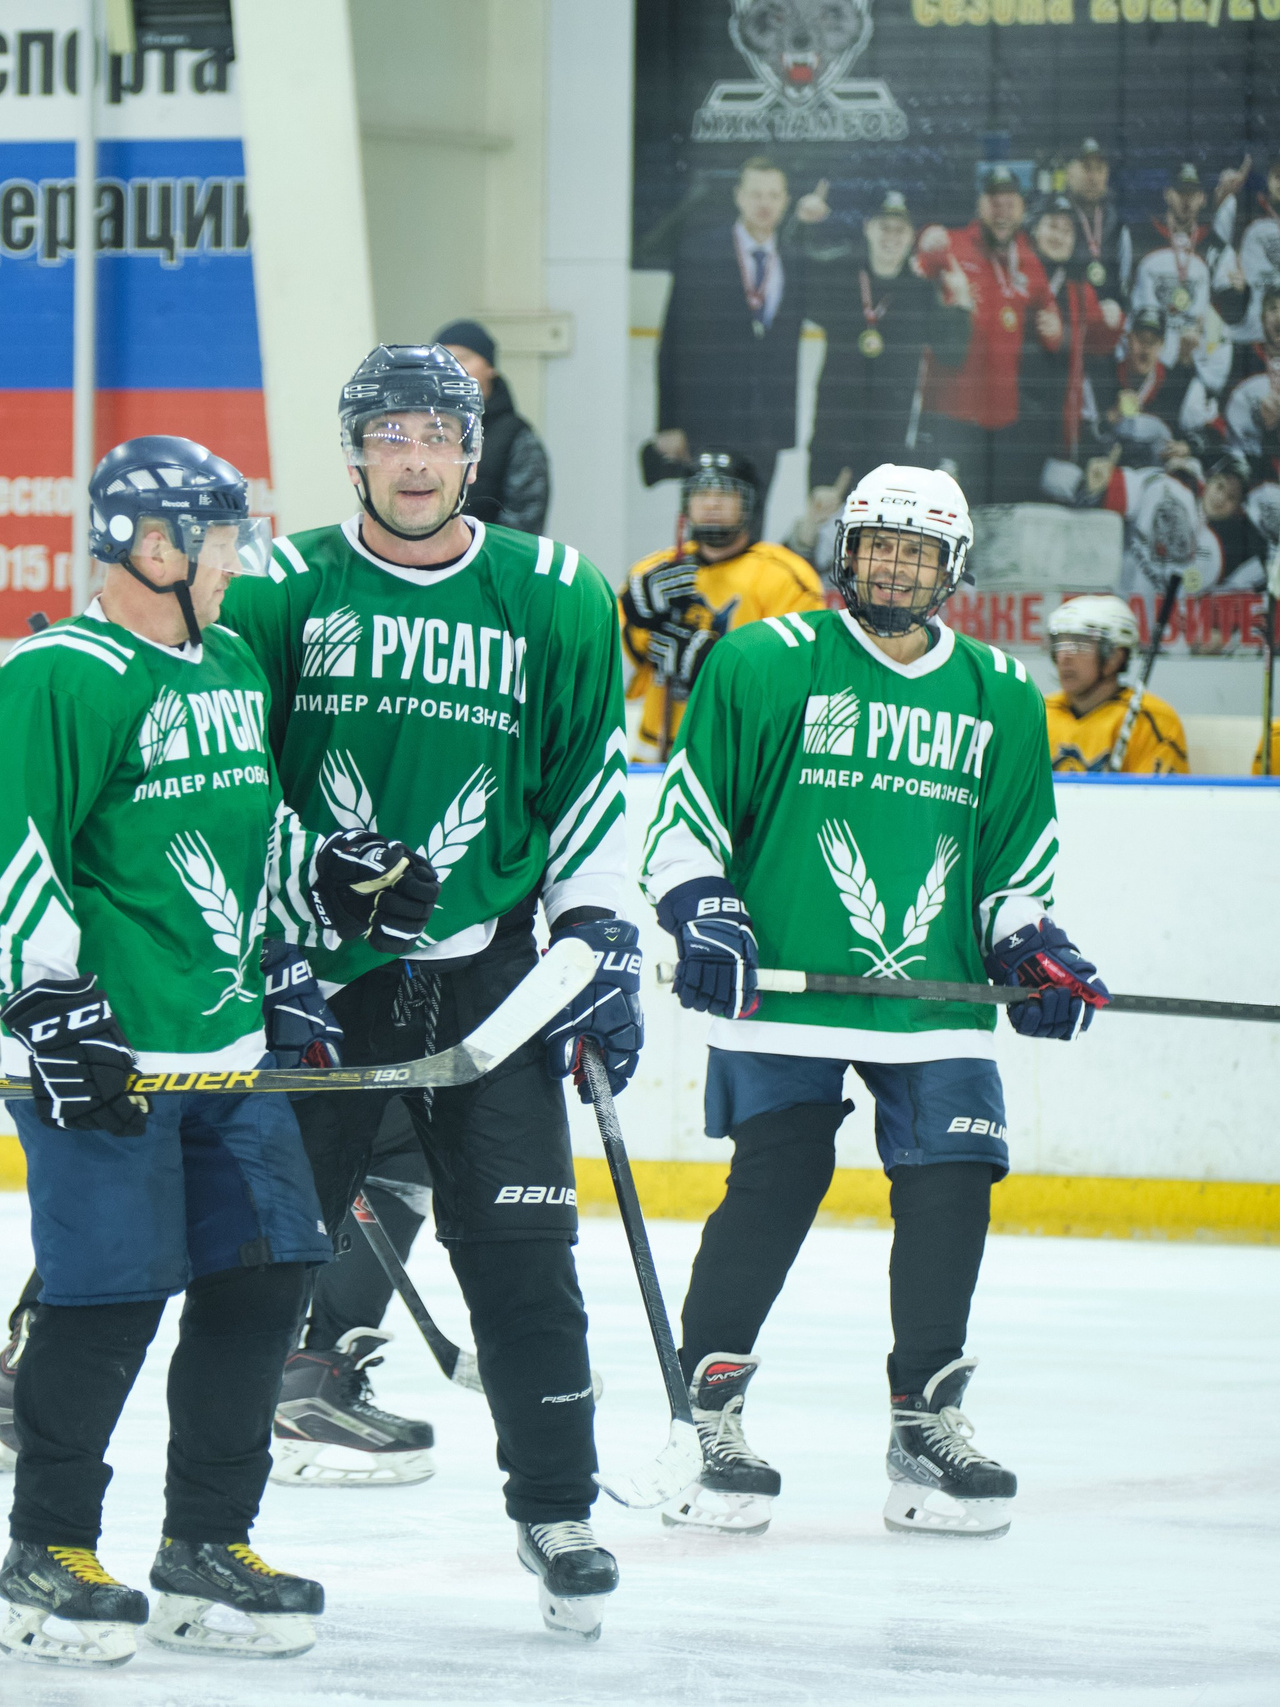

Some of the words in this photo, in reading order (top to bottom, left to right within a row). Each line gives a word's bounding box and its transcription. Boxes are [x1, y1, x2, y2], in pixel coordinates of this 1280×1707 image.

[880, 496, 917, 507] CCM
[294, 694, 368, 715] ЛИДЕР
[132, 773, 206, 803] ЛИДЕР
[799, 768, 864, 788] ЛИДЕР
